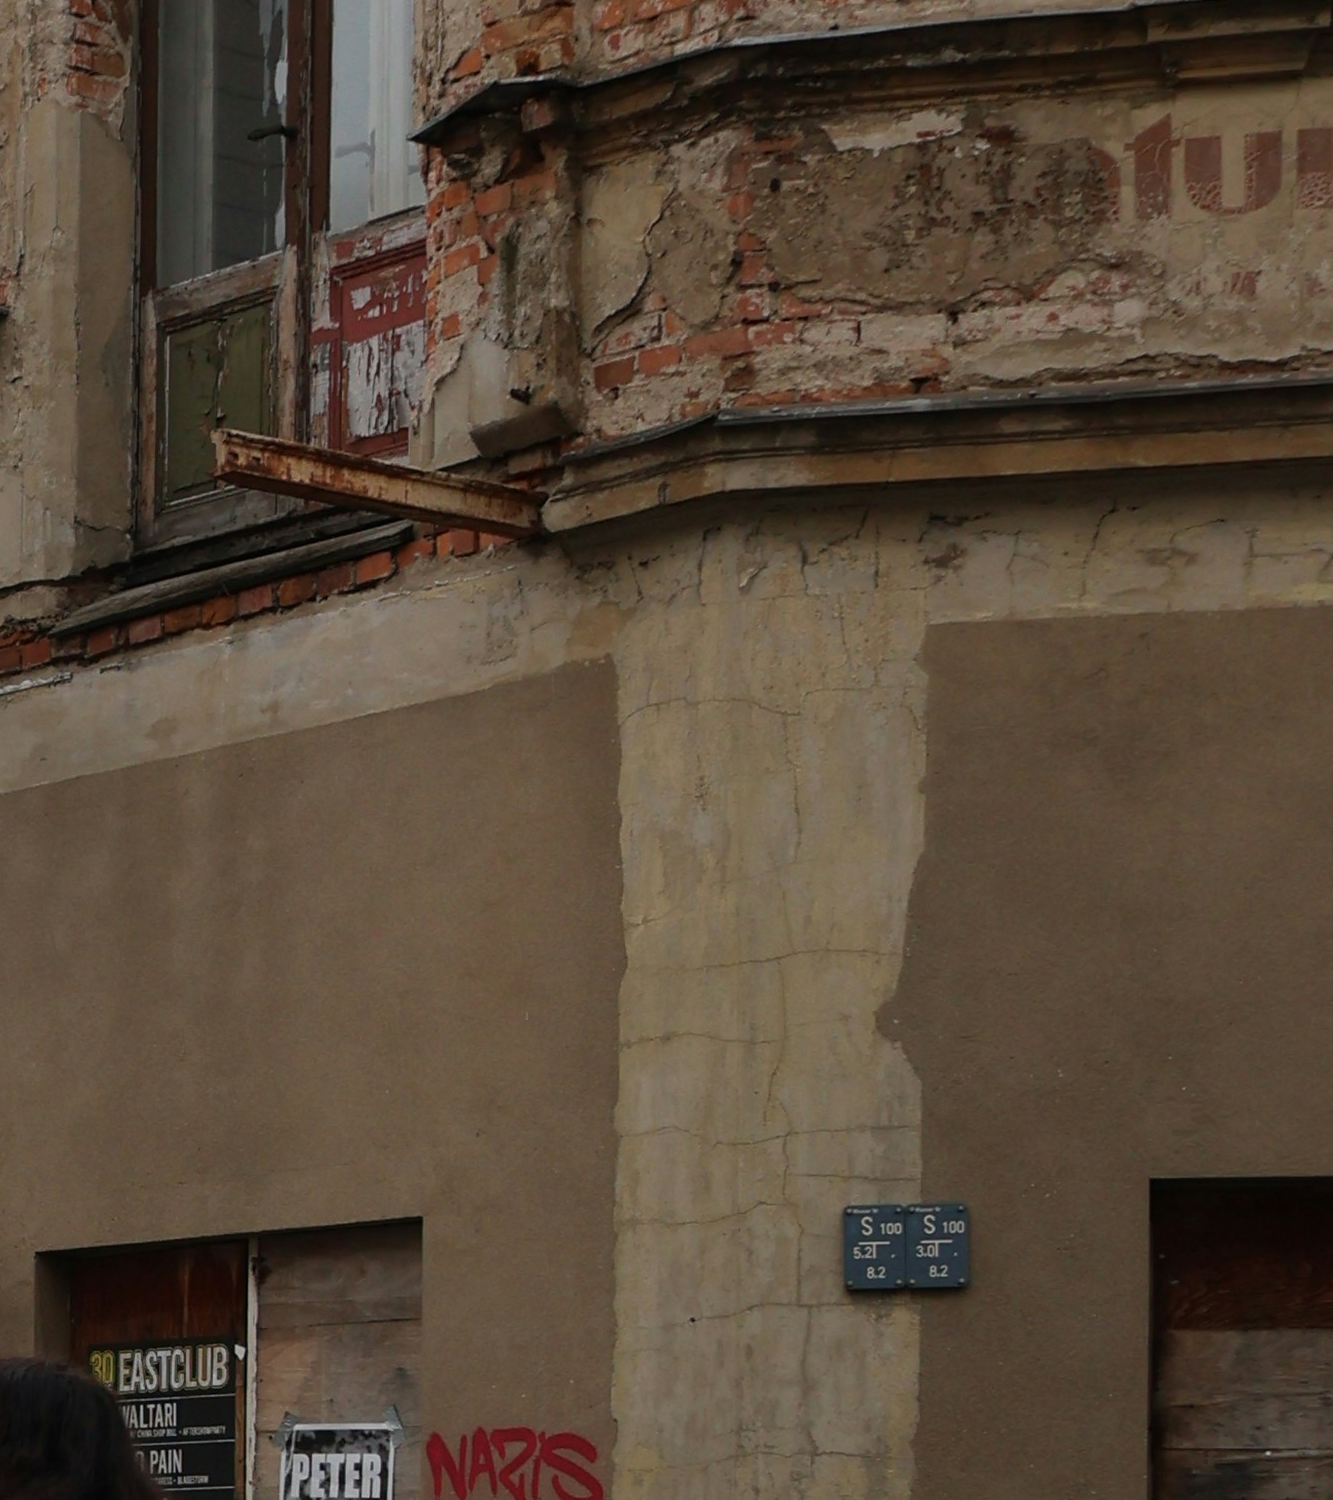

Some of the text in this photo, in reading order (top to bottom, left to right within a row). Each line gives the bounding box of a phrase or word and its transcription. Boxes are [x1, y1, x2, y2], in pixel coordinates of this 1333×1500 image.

[861, 1216, 903, 1236] S 100
[923, 1214, 965, 1235] S 100
[853, 1246, 873, 1260] 5.2
[916, 1244, 935, 1258] 3.0
[866, 1266, 886, 1279] 8.2
[929, 1265, 948, 1278] 8.2
[118, 1344, 229, 1393] EASTCLUB
[149, 1449, 183, 1475] PAIN
[291, 1453, 382, 1499] PETER
